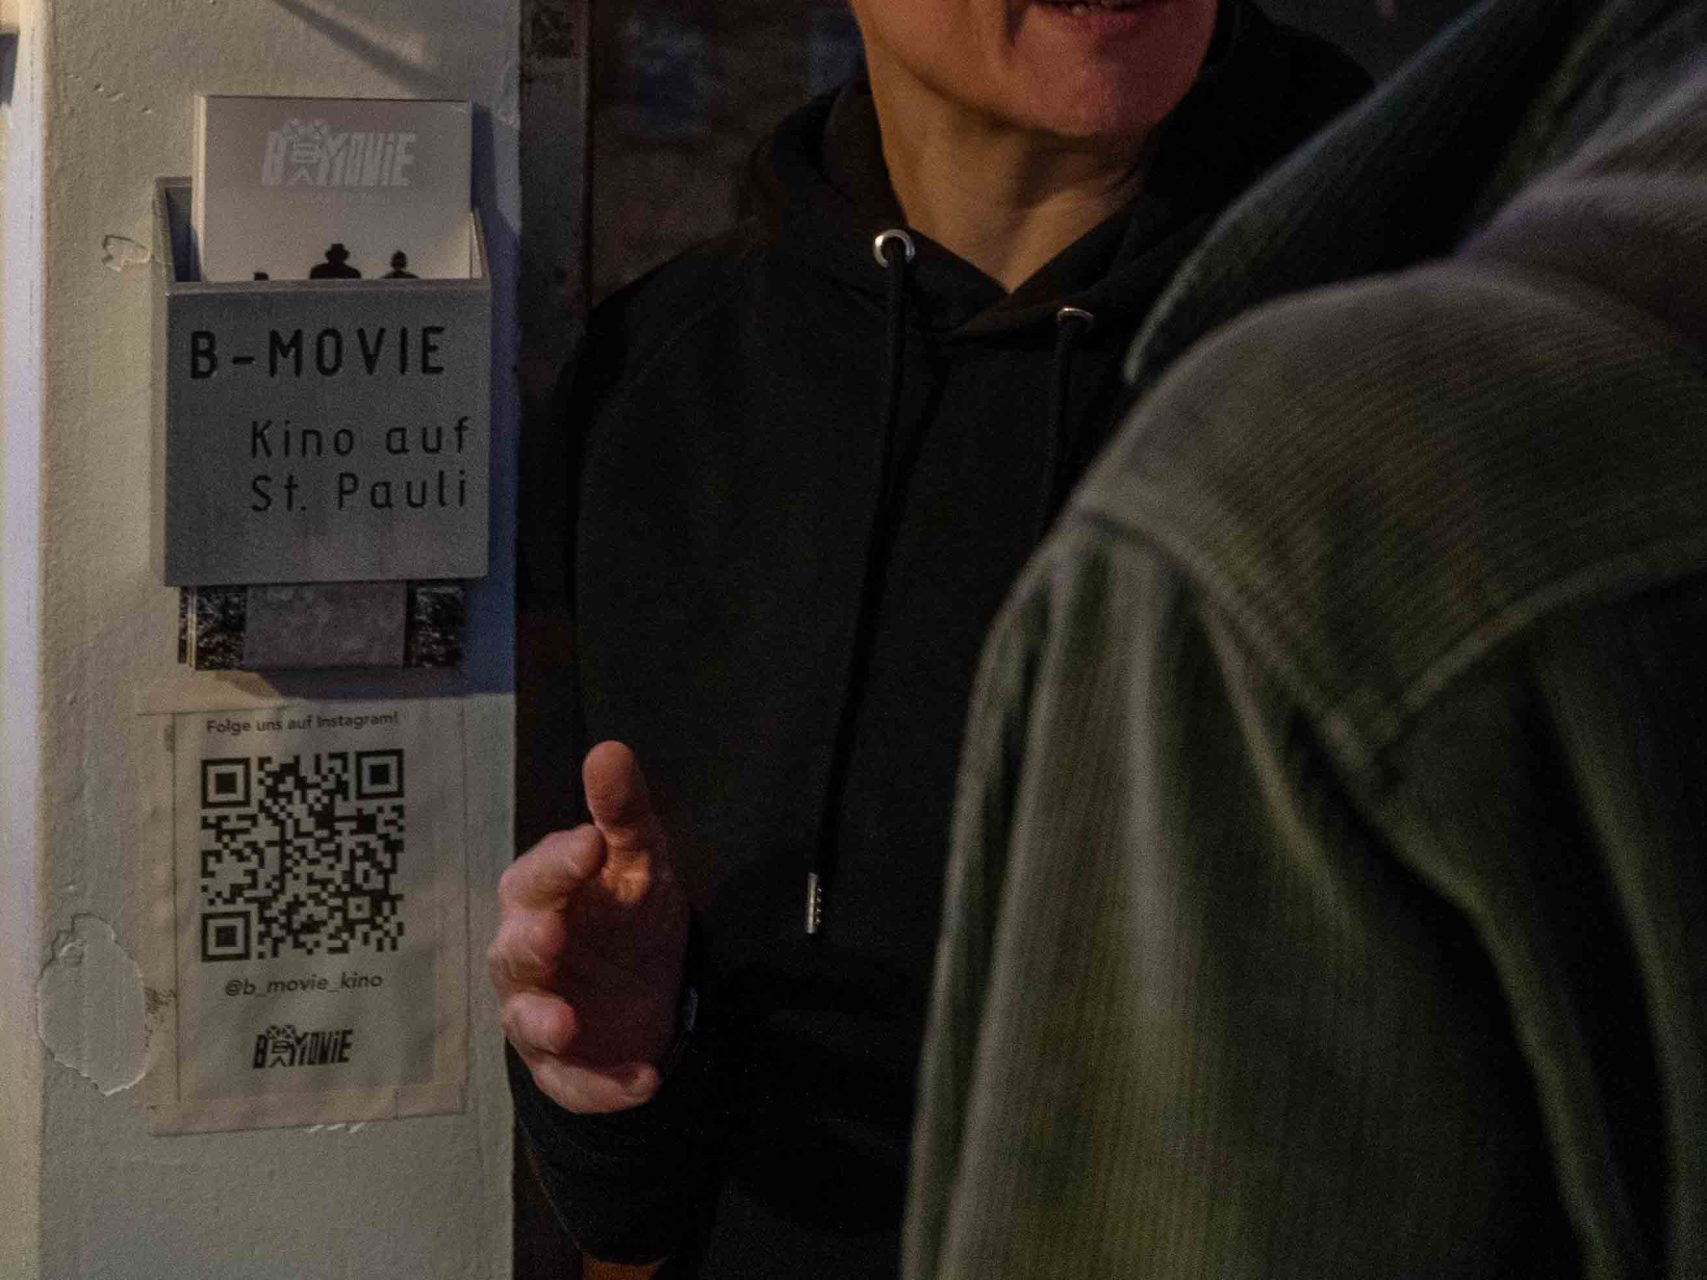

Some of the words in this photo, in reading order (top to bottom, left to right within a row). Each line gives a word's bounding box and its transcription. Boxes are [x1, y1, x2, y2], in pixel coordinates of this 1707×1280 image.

[189, 325, 446, 380] B-MOVIE
[251, 418, 355, 459] Kino
[385, 415, 470, 456] auf
[251, 473, 307, 513] St.
[337, 469, 467, 510] Pauli
[207, 718, 251, 736] Folge
[256, 720, 283, 732] uns
[287, 715, 313, 730] auf
[317, 710, 399, 730] Instagram!
[224, 970, 384, 998] @b_movie_kino
